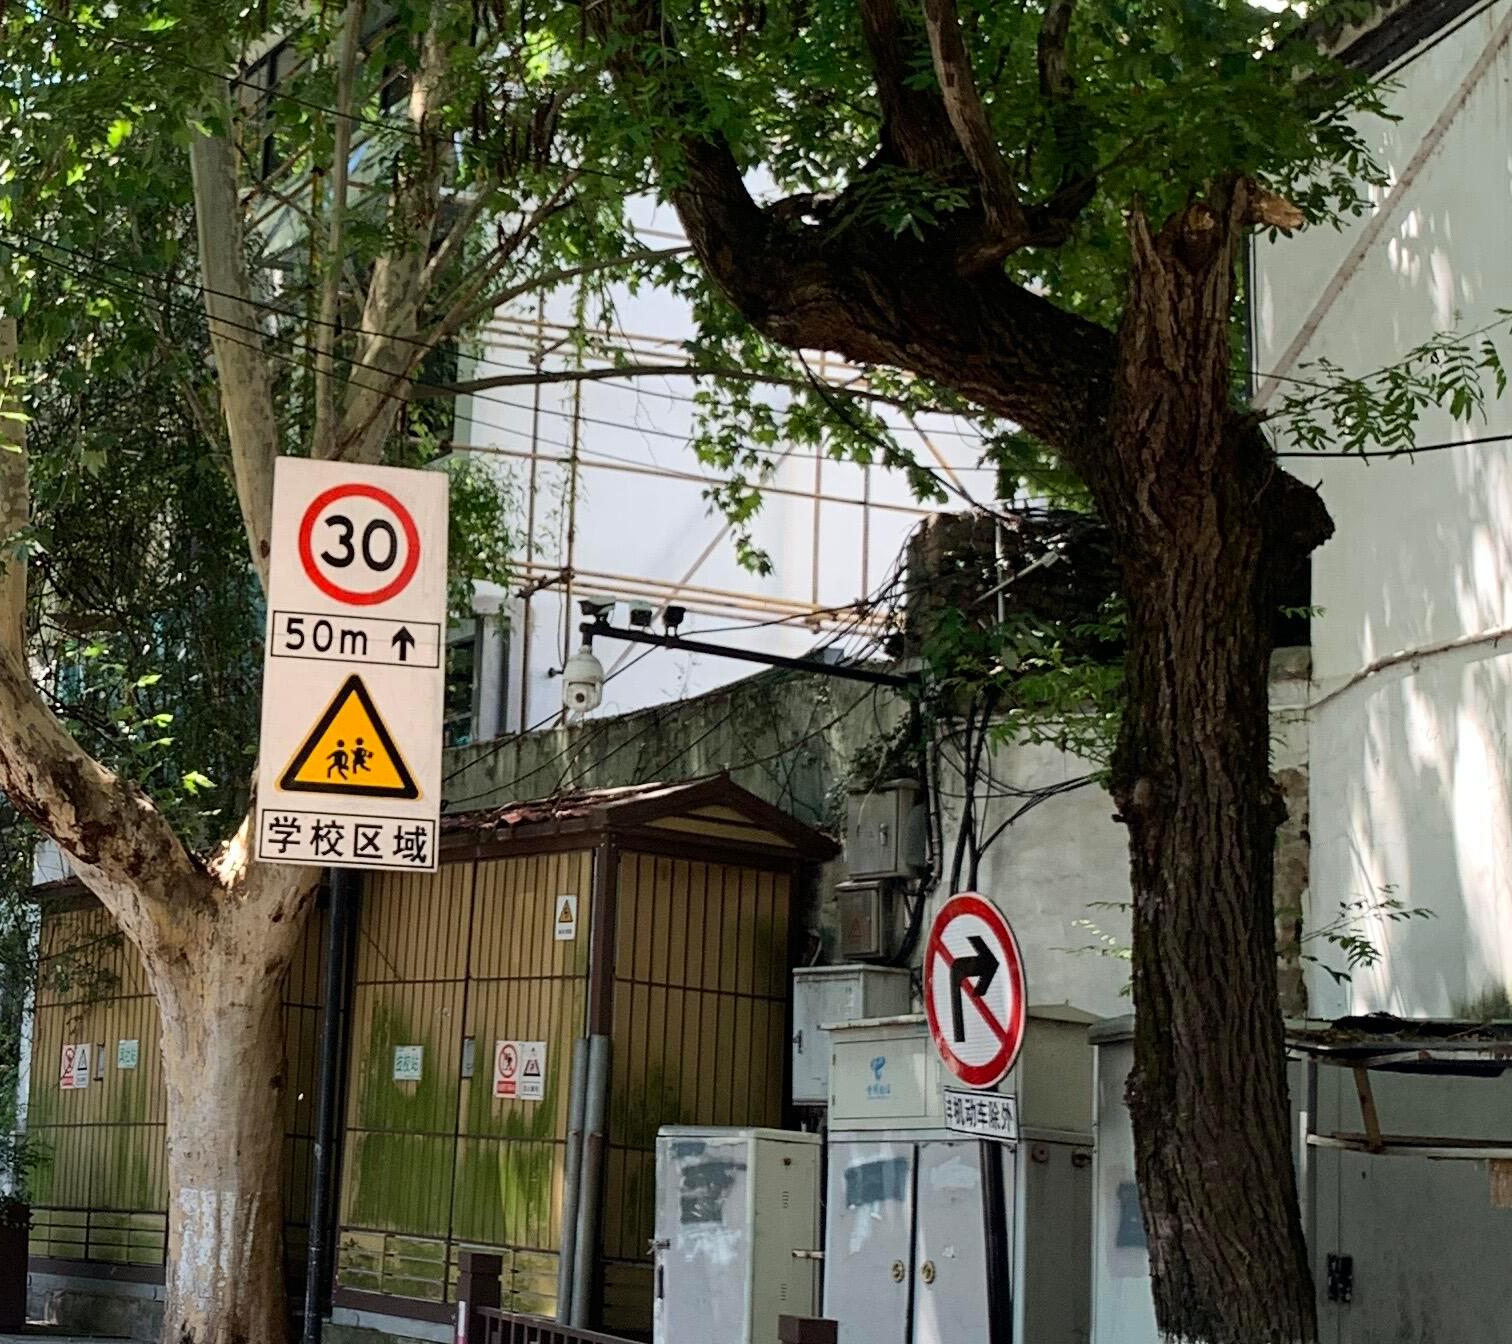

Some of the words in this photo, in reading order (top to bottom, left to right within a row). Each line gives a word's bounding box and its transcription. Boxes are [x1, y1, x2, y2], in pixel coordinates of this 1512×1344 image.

[321, 515, 398, 572] 30
[286, 617, 367, 655] 50m
[268, 816, 427, 863] 学校区域
